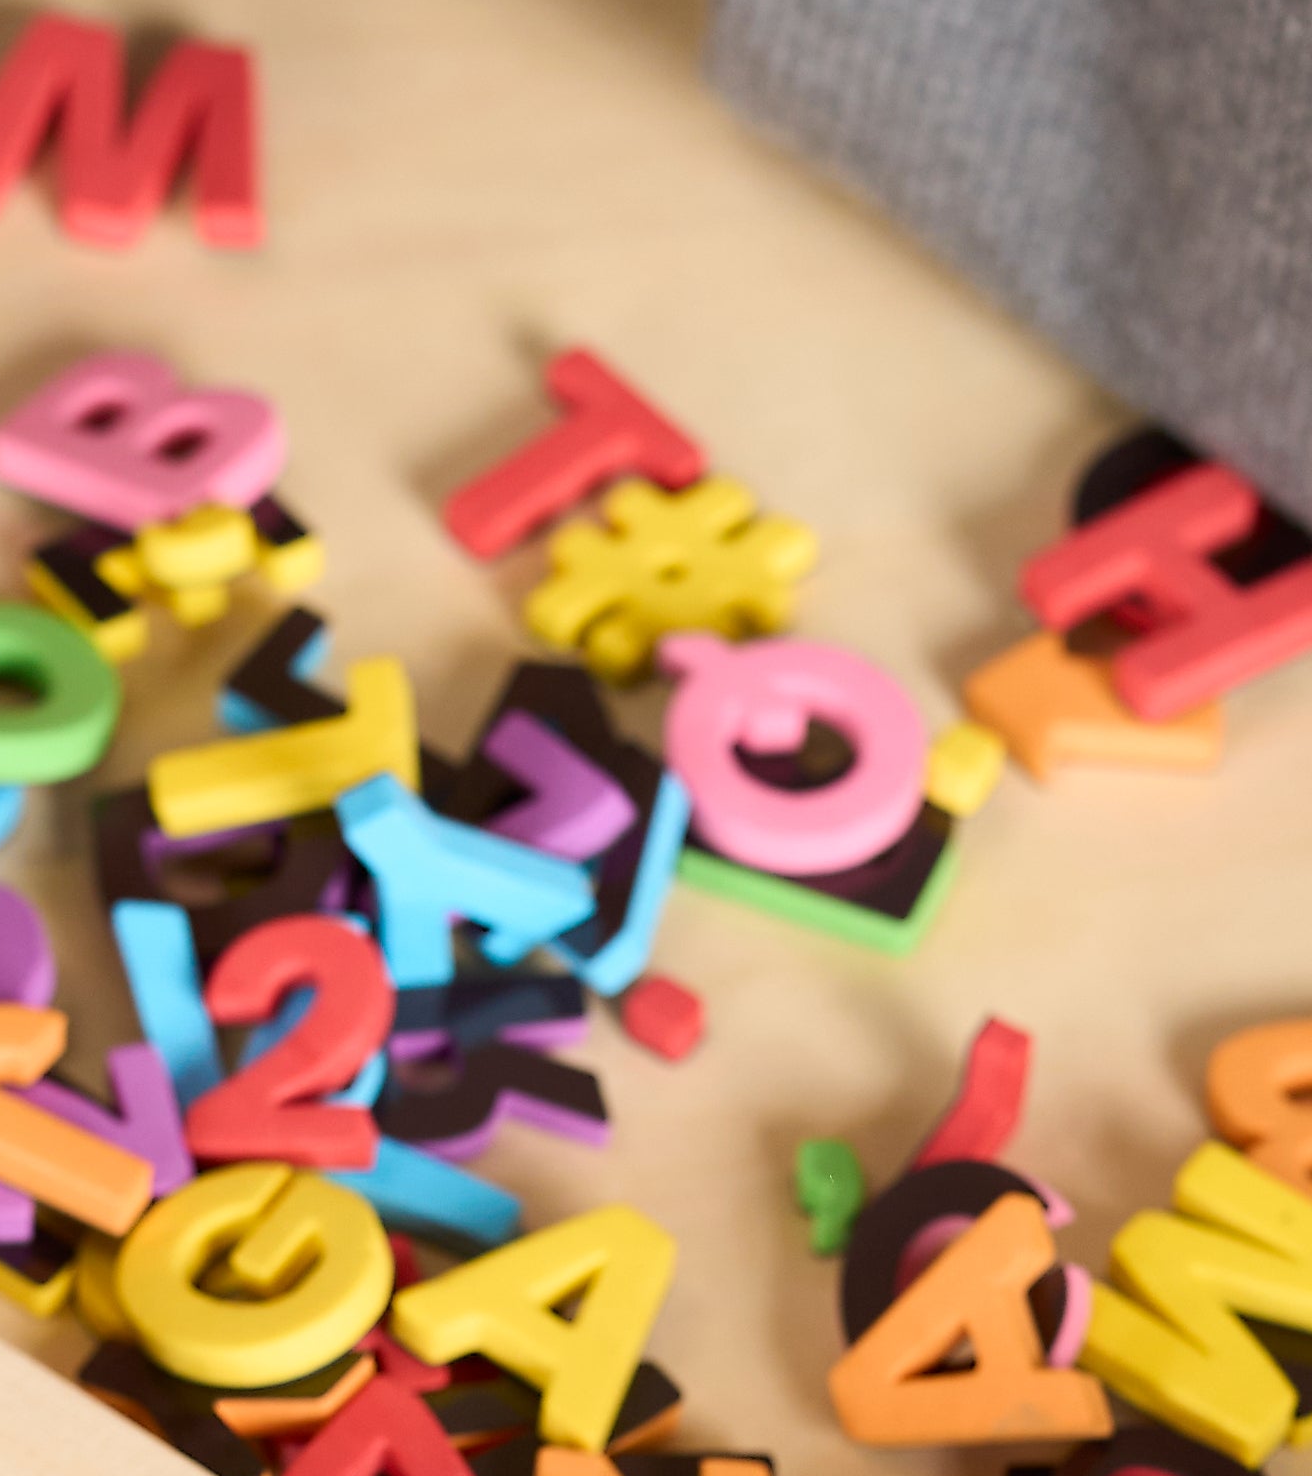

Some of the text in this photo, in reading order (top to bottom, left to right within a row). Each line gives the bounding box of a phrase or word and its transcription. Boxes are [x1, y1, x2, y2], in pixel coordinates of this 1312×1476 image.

[656, 630, 930, 876] Q
[181, 910, 398, 1174] 2
[114, 1159, 396, 1389] G
[389, 1202, 680, 1454] A
[827, 1190, 1116, 1446] A
